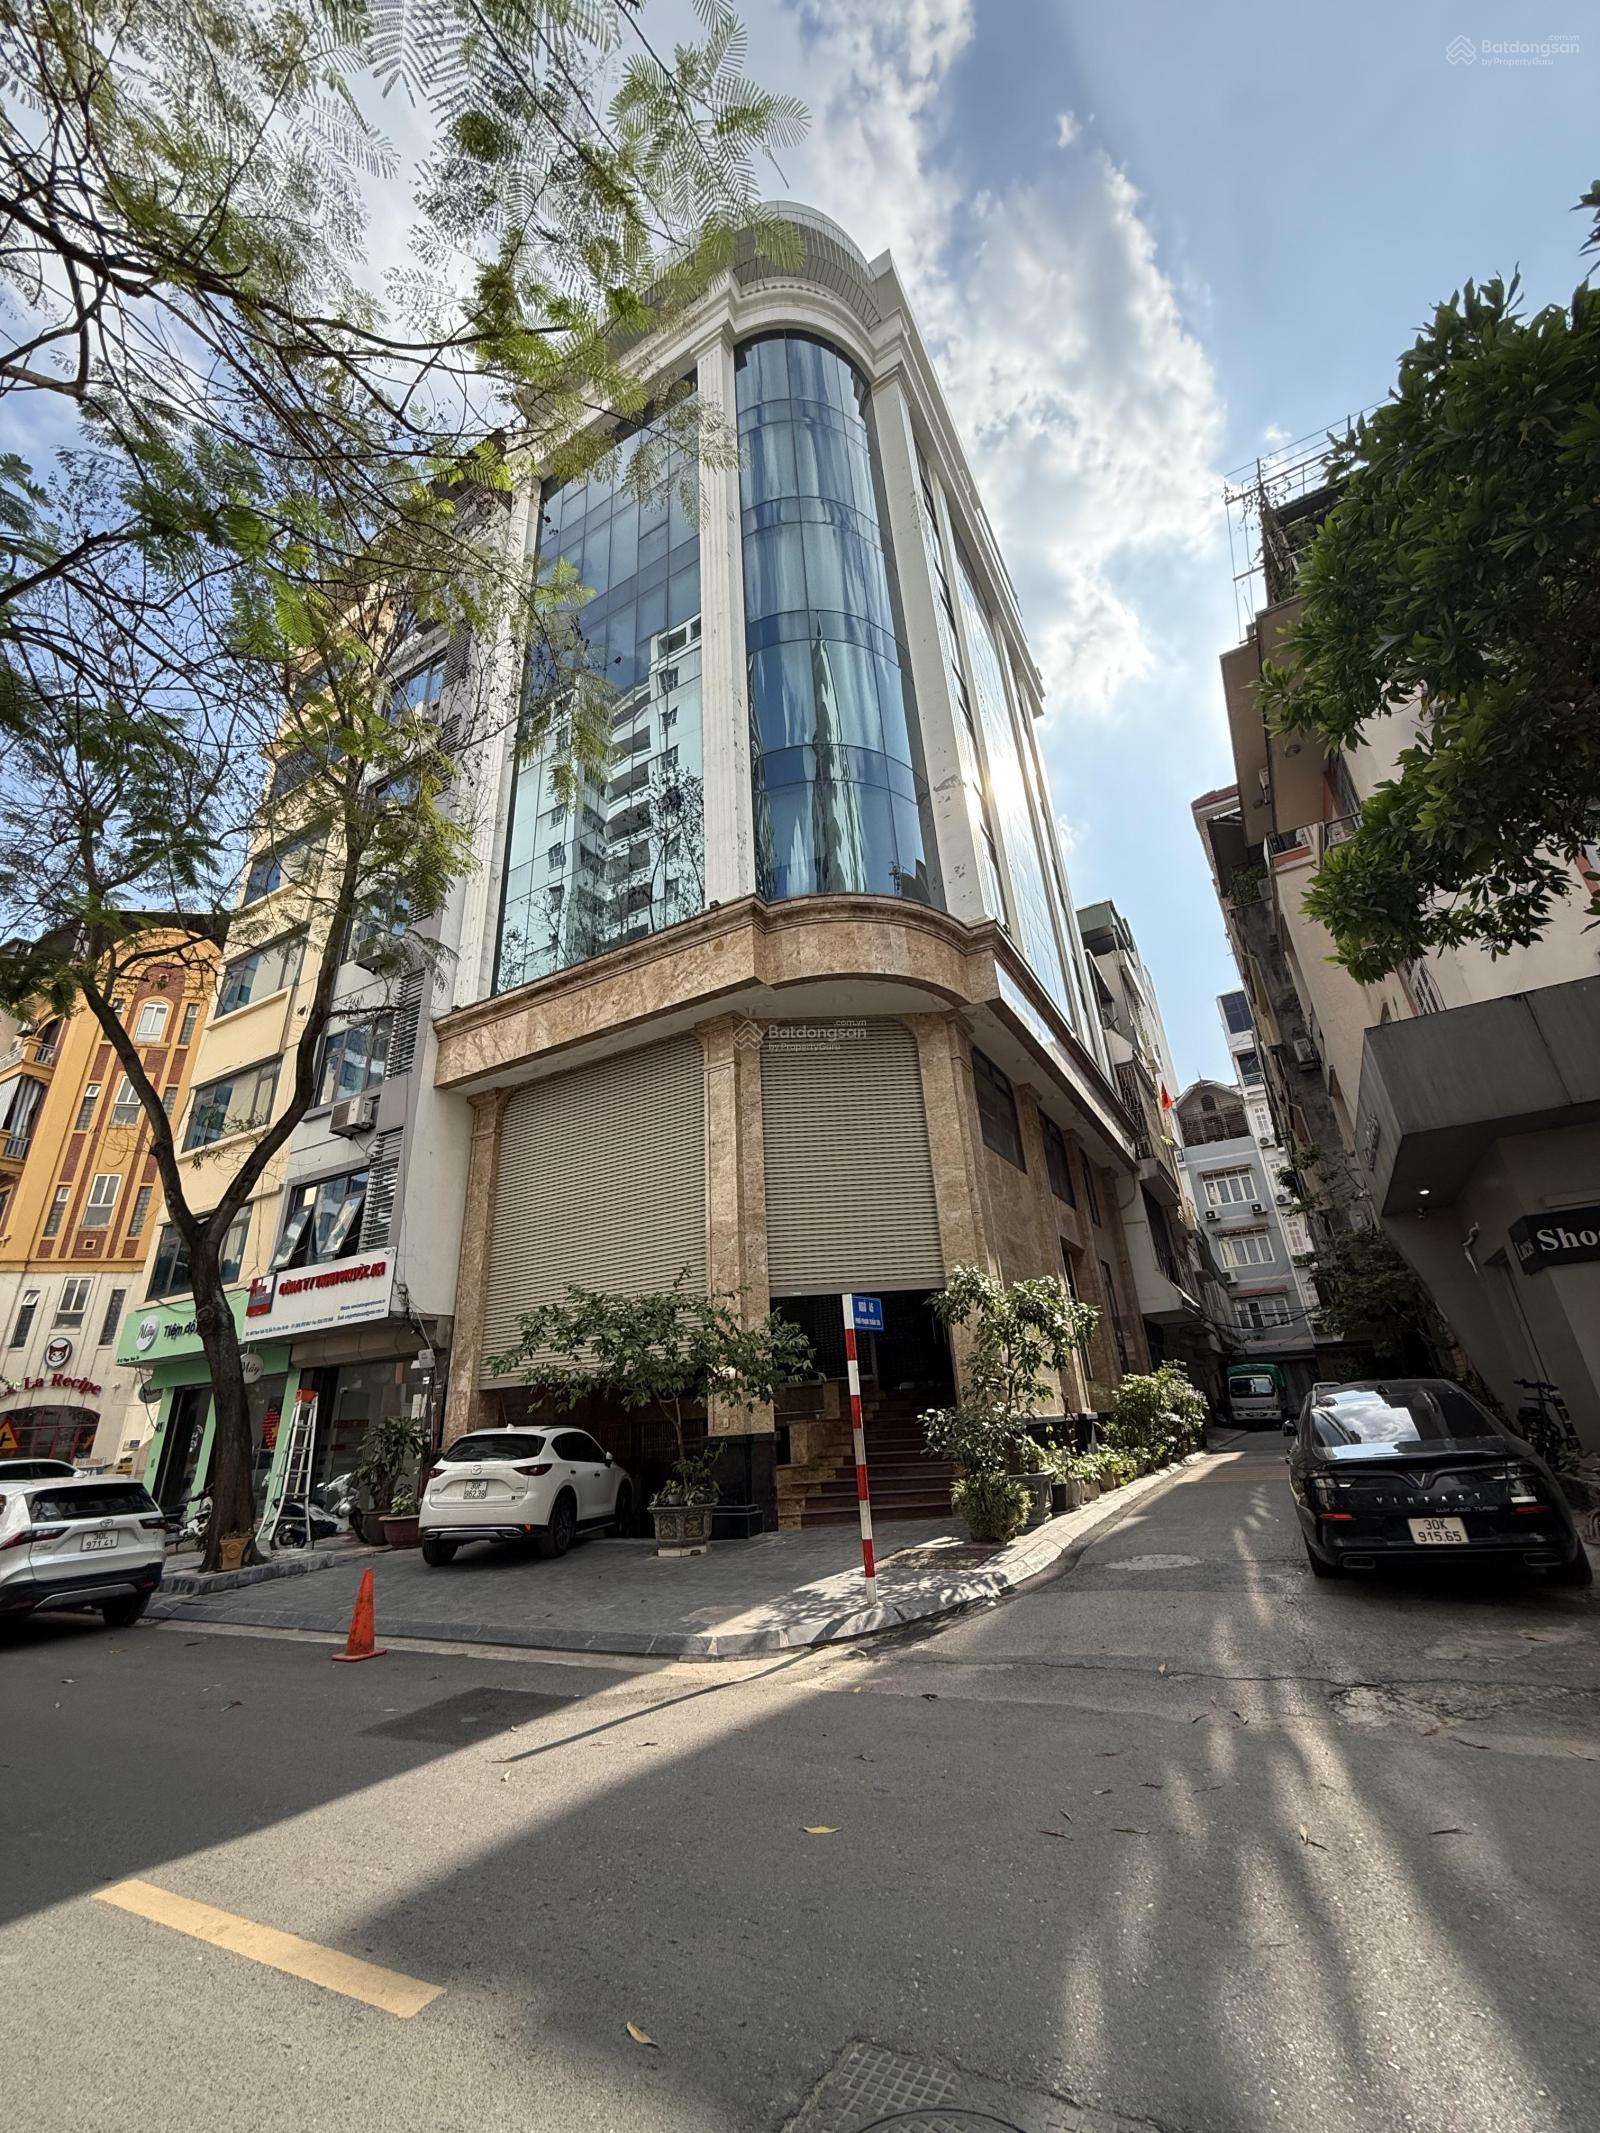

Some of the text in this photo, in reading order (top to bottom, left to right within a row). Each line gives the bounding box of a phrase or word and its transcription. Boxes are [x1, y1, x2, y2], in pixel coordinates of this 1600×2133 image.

[1536, 1227, 1600, 1251] Sho
[23, 1373, 102, 1395] La Recipe
[1376, 1492, 1481, 1505] VINFAST
[1423, 1519, 1448, 1530] 30K
[93, 1531, 109, 1540] 30L
[1418, 1531, 1462, 1542] 915.65
